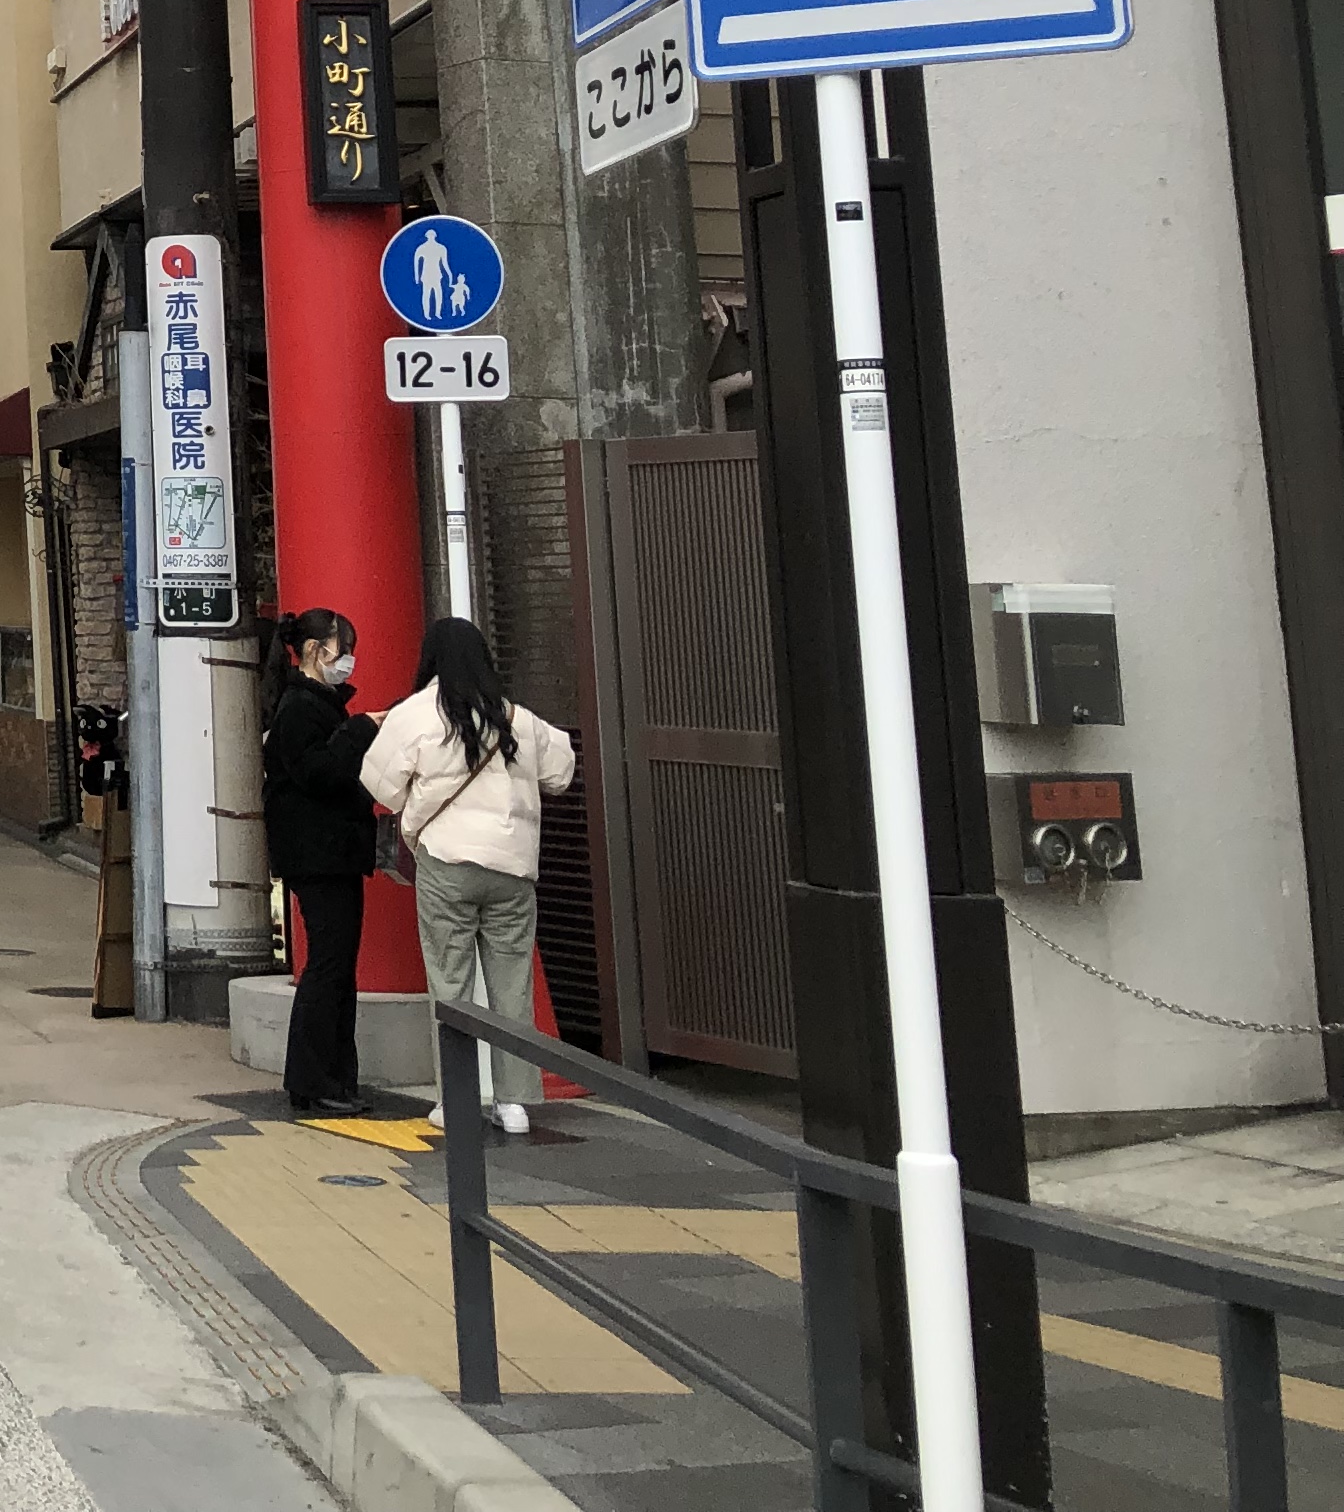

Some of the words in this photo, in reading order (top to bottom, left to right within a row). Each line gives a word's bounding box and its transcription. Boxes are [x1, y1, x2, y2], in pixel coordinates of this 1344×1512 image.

[322, 18, 376, 182] 小町通り
[586, 38, 683, 140] ここから
[165, 291, 200, 351] 赤尾
[396, 350, 500, 389] 12-16
[172, 412, 205, 470] 医院
[163, 553, 229, 568] 0467-25-3387
[180, 602, 212, 615] 1-5
